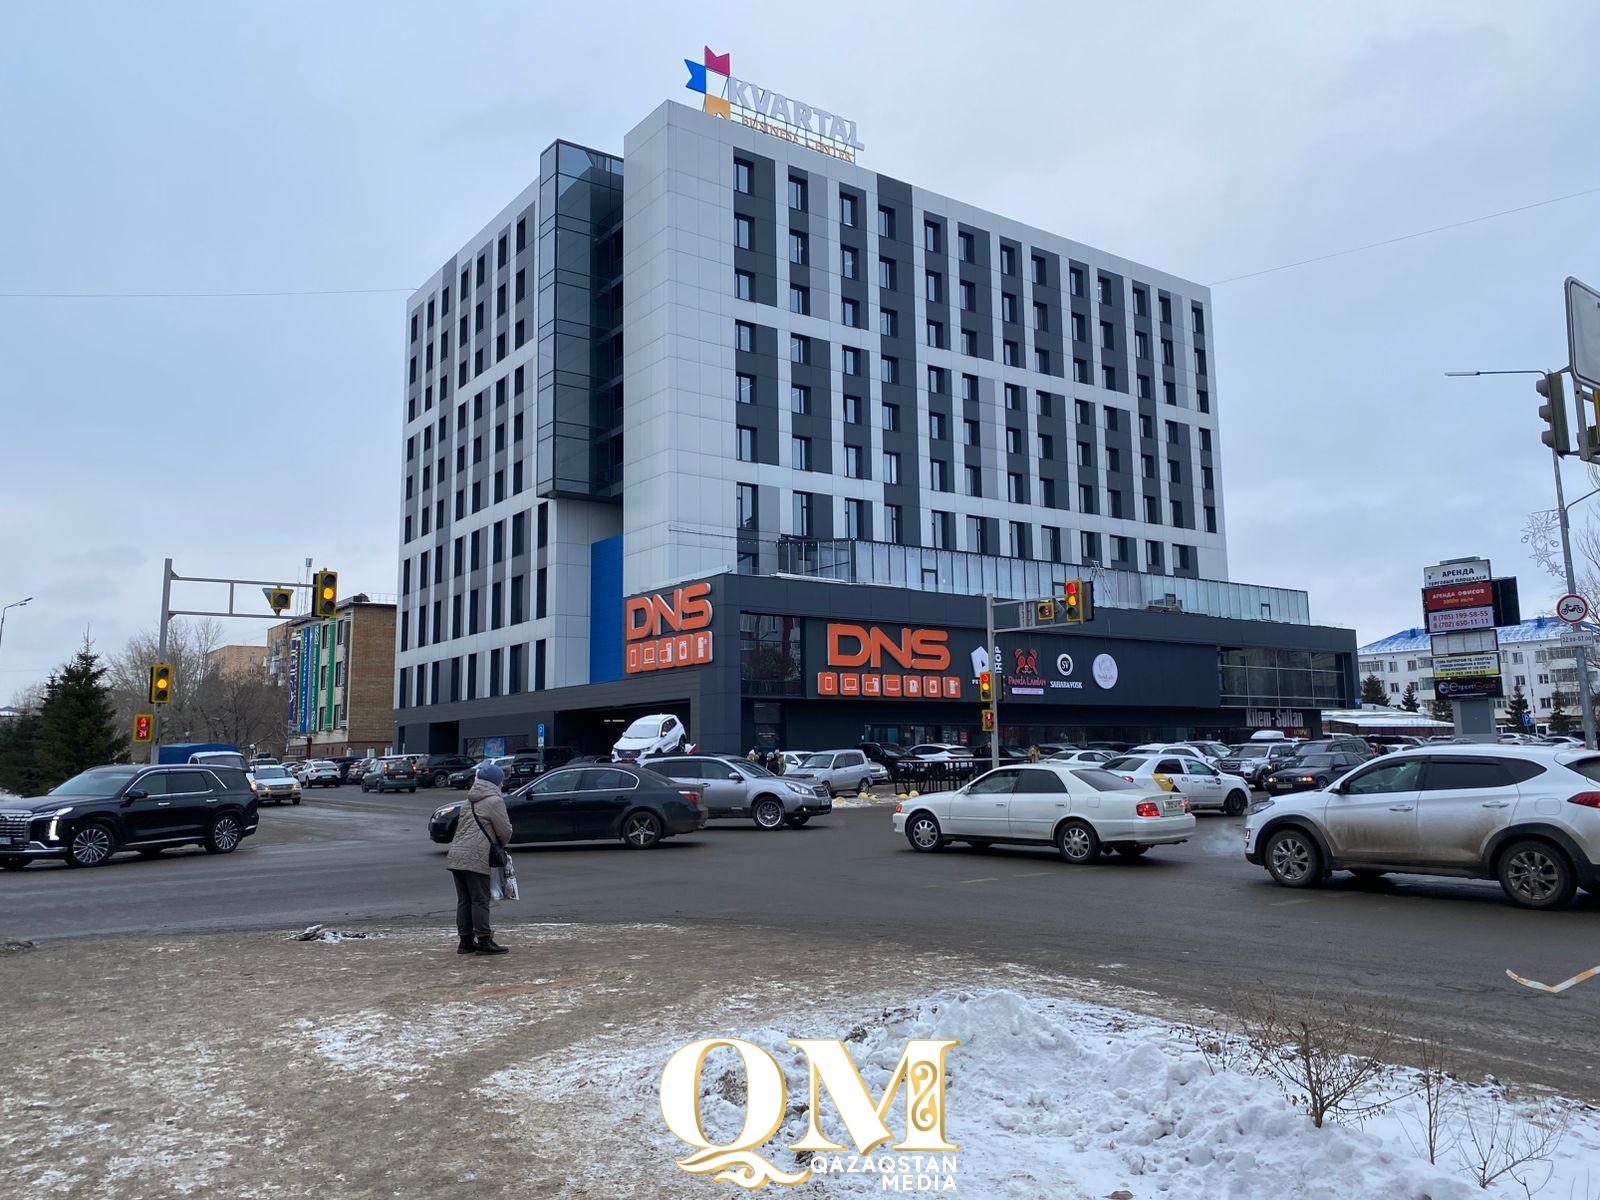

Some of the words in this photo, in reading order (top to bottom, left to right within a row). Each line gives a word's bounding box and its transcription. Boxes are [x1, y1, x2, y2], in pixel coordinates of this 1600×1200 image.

[728, 76, 865, 151] KVARTAL
[742, 115, 799, 143] BUSINESS
[1442, 568, 1474, 577] АРЕНДА
[625, 582, 713, 641] DNS
[1432, 591, 1456, 599] АРЕНДА
[1457, 588, 1485, 596] ОФИСОВ
[826, 623, 951, 670] DNS
